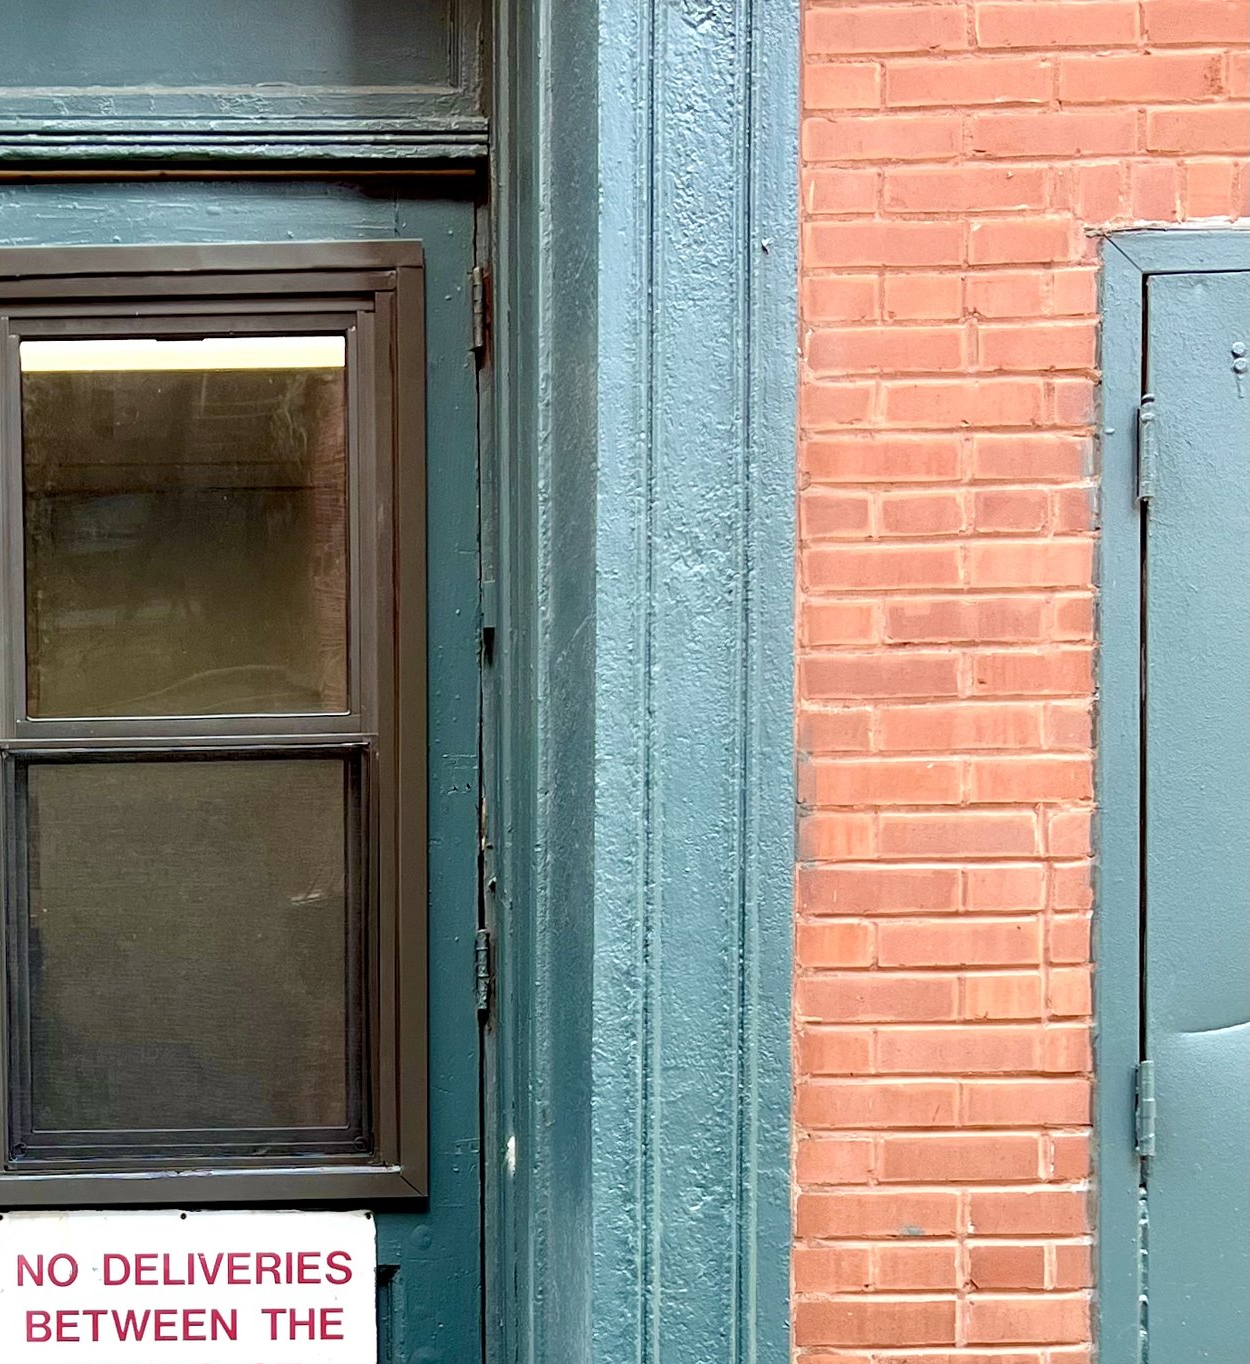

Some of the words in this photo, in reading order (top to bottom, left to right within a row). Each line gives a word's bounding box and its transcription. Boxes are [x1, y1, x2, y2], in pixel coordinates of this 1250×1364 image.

[17, 1253, 79, 1287] NO
[103, 1251, 353, 1286] DELIVERIES
[26, 1309, 237, 1342] BETWEEN
[261, 1308, 344, 1341] THE
